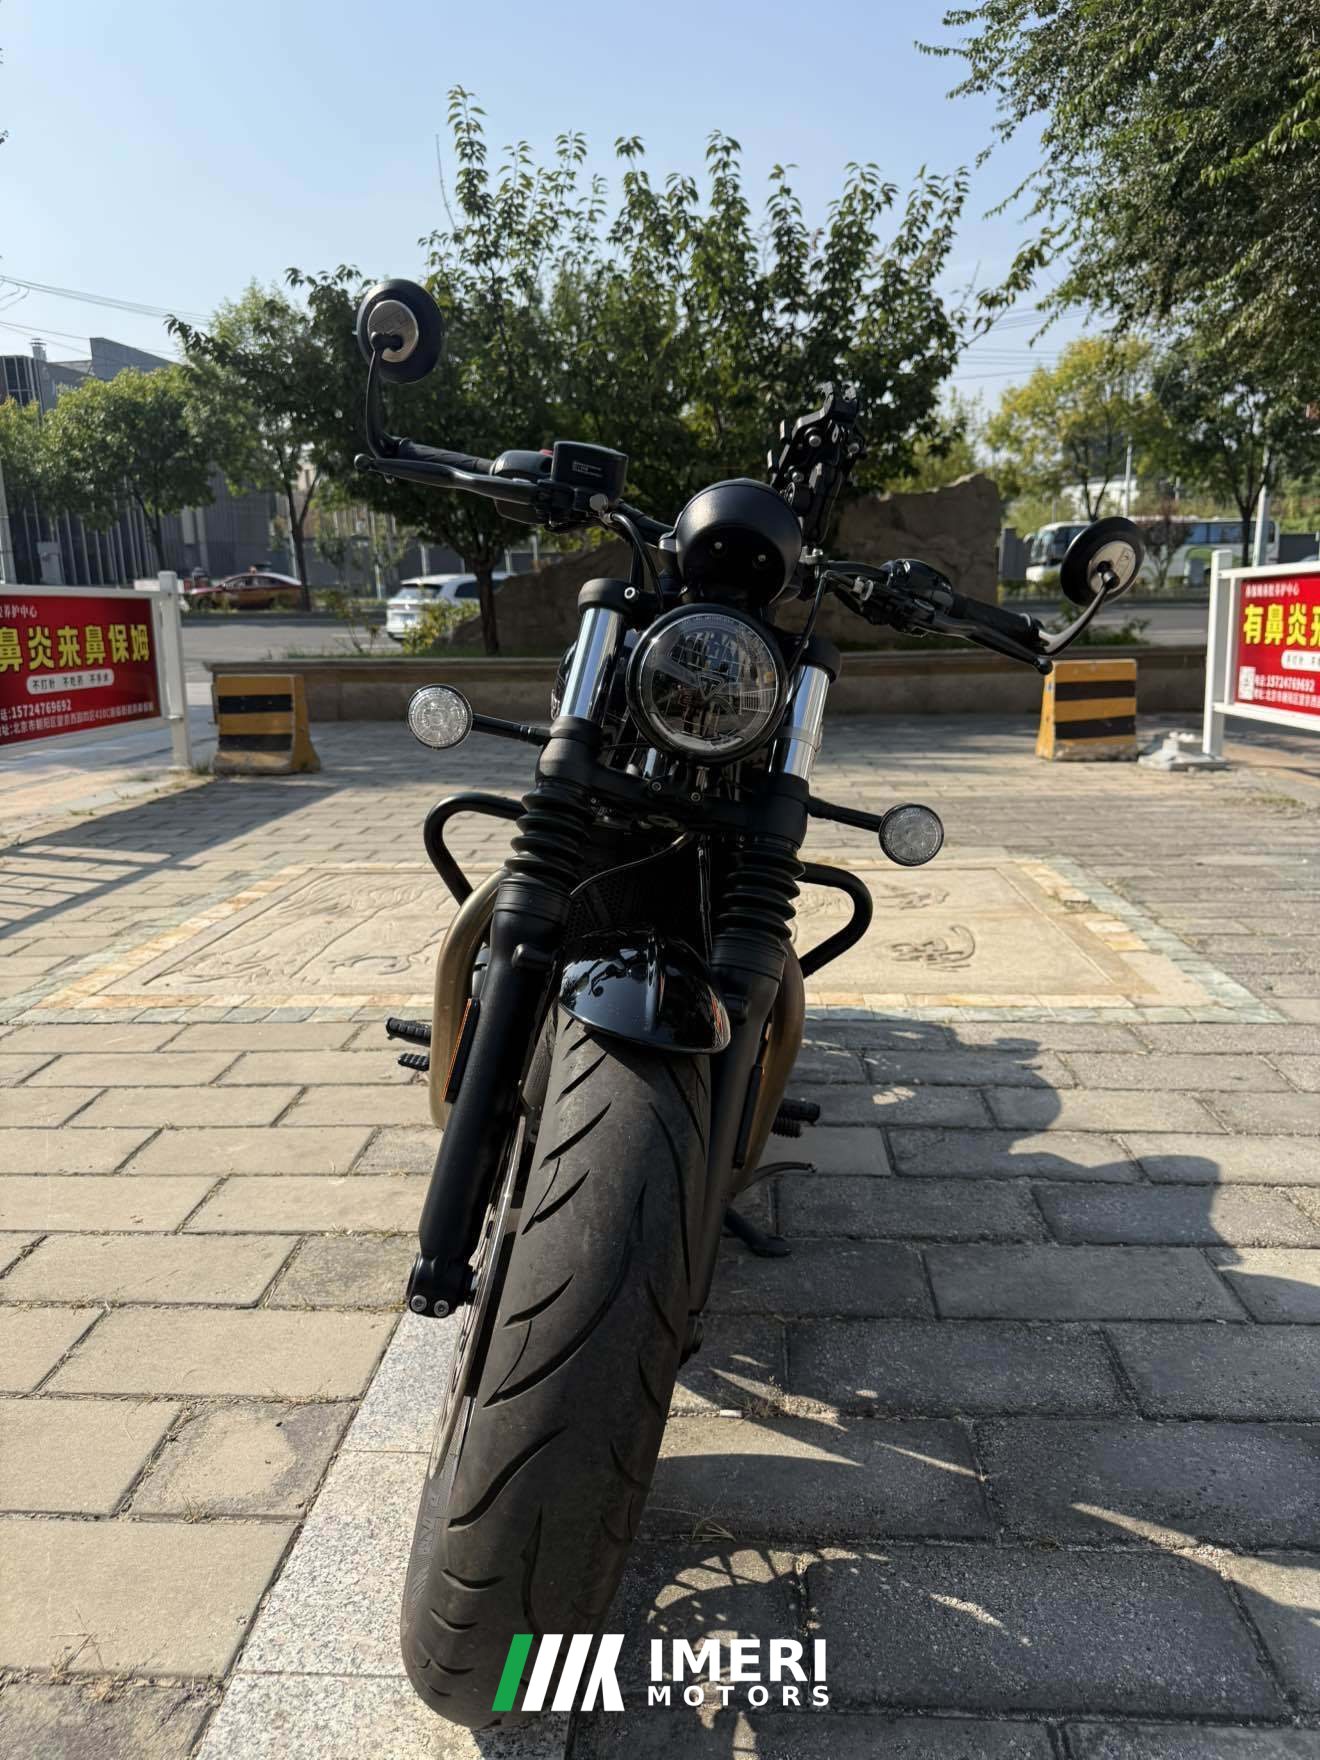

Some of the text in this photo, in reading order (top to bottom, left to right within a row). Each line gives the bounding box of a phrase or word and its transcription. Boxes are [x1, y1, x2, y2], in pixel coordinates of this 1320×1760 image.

[0, 624, 149, 672] 鼻炎来鼻保姆
